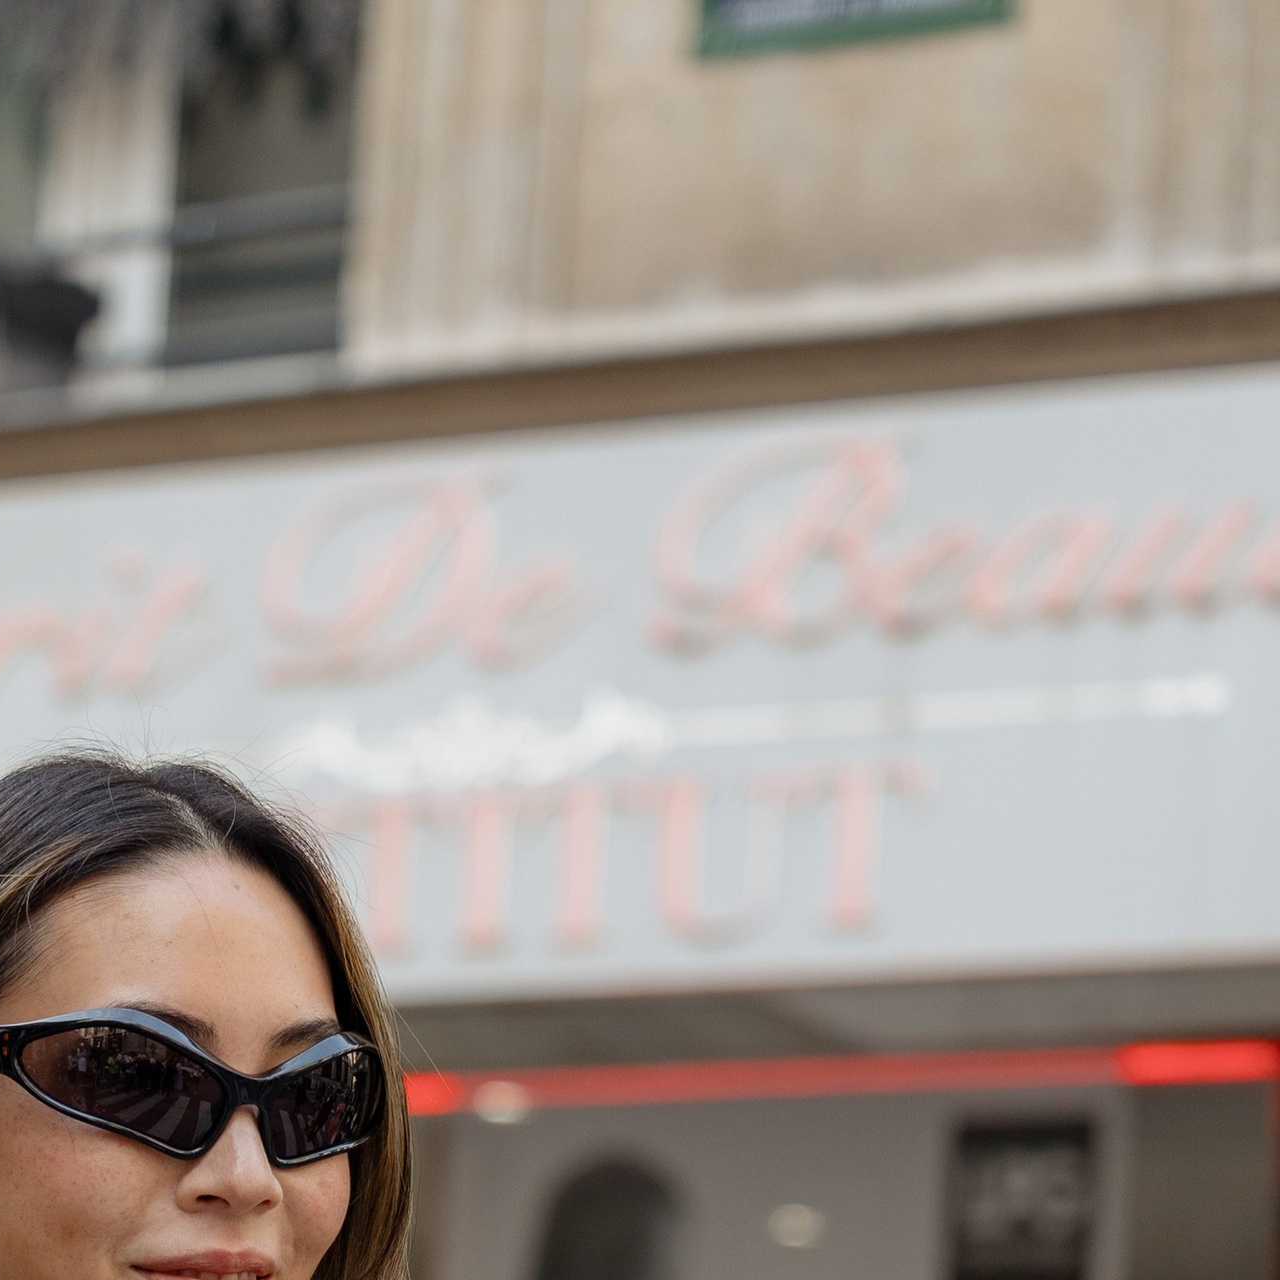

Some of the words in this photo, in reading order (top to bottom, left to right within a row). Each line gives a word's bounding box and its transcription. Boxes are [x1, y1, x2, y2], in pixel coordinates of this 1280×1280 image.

[261, 460, 598, 686] De
[643, 428, 1280, 652] Beau
[322, 757, 932, 958] TITUT
